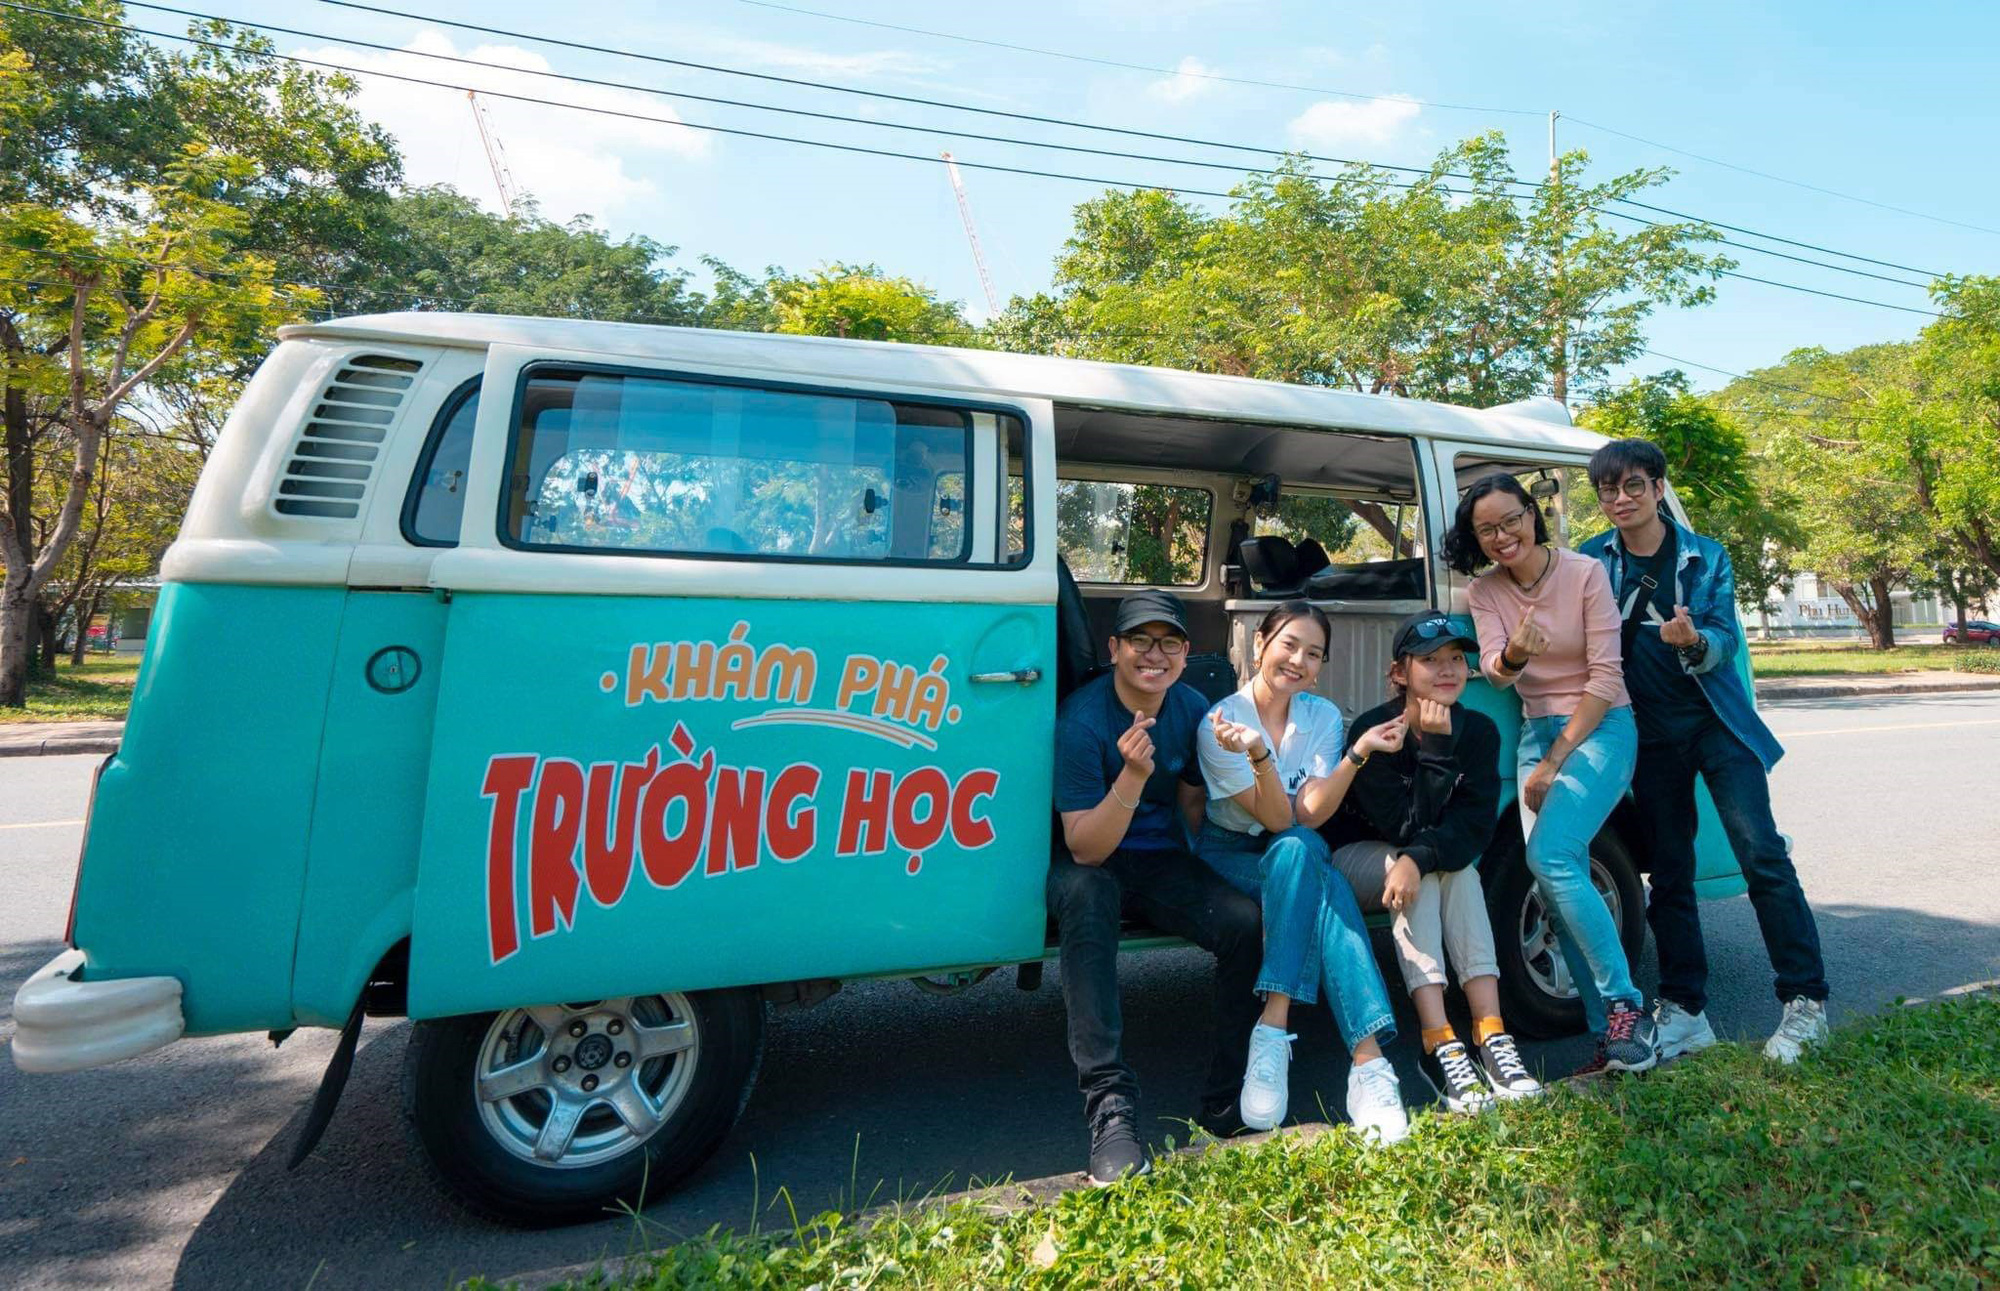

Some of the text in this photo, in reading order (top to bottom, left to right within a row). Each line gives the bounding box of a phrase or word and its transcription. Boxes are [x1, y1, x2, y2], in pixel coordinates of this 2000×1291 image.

[625, 620, 949, 731] KHÁM PHÁ
[480, 719, 1001, 967] TRƯỜNG HỌC
